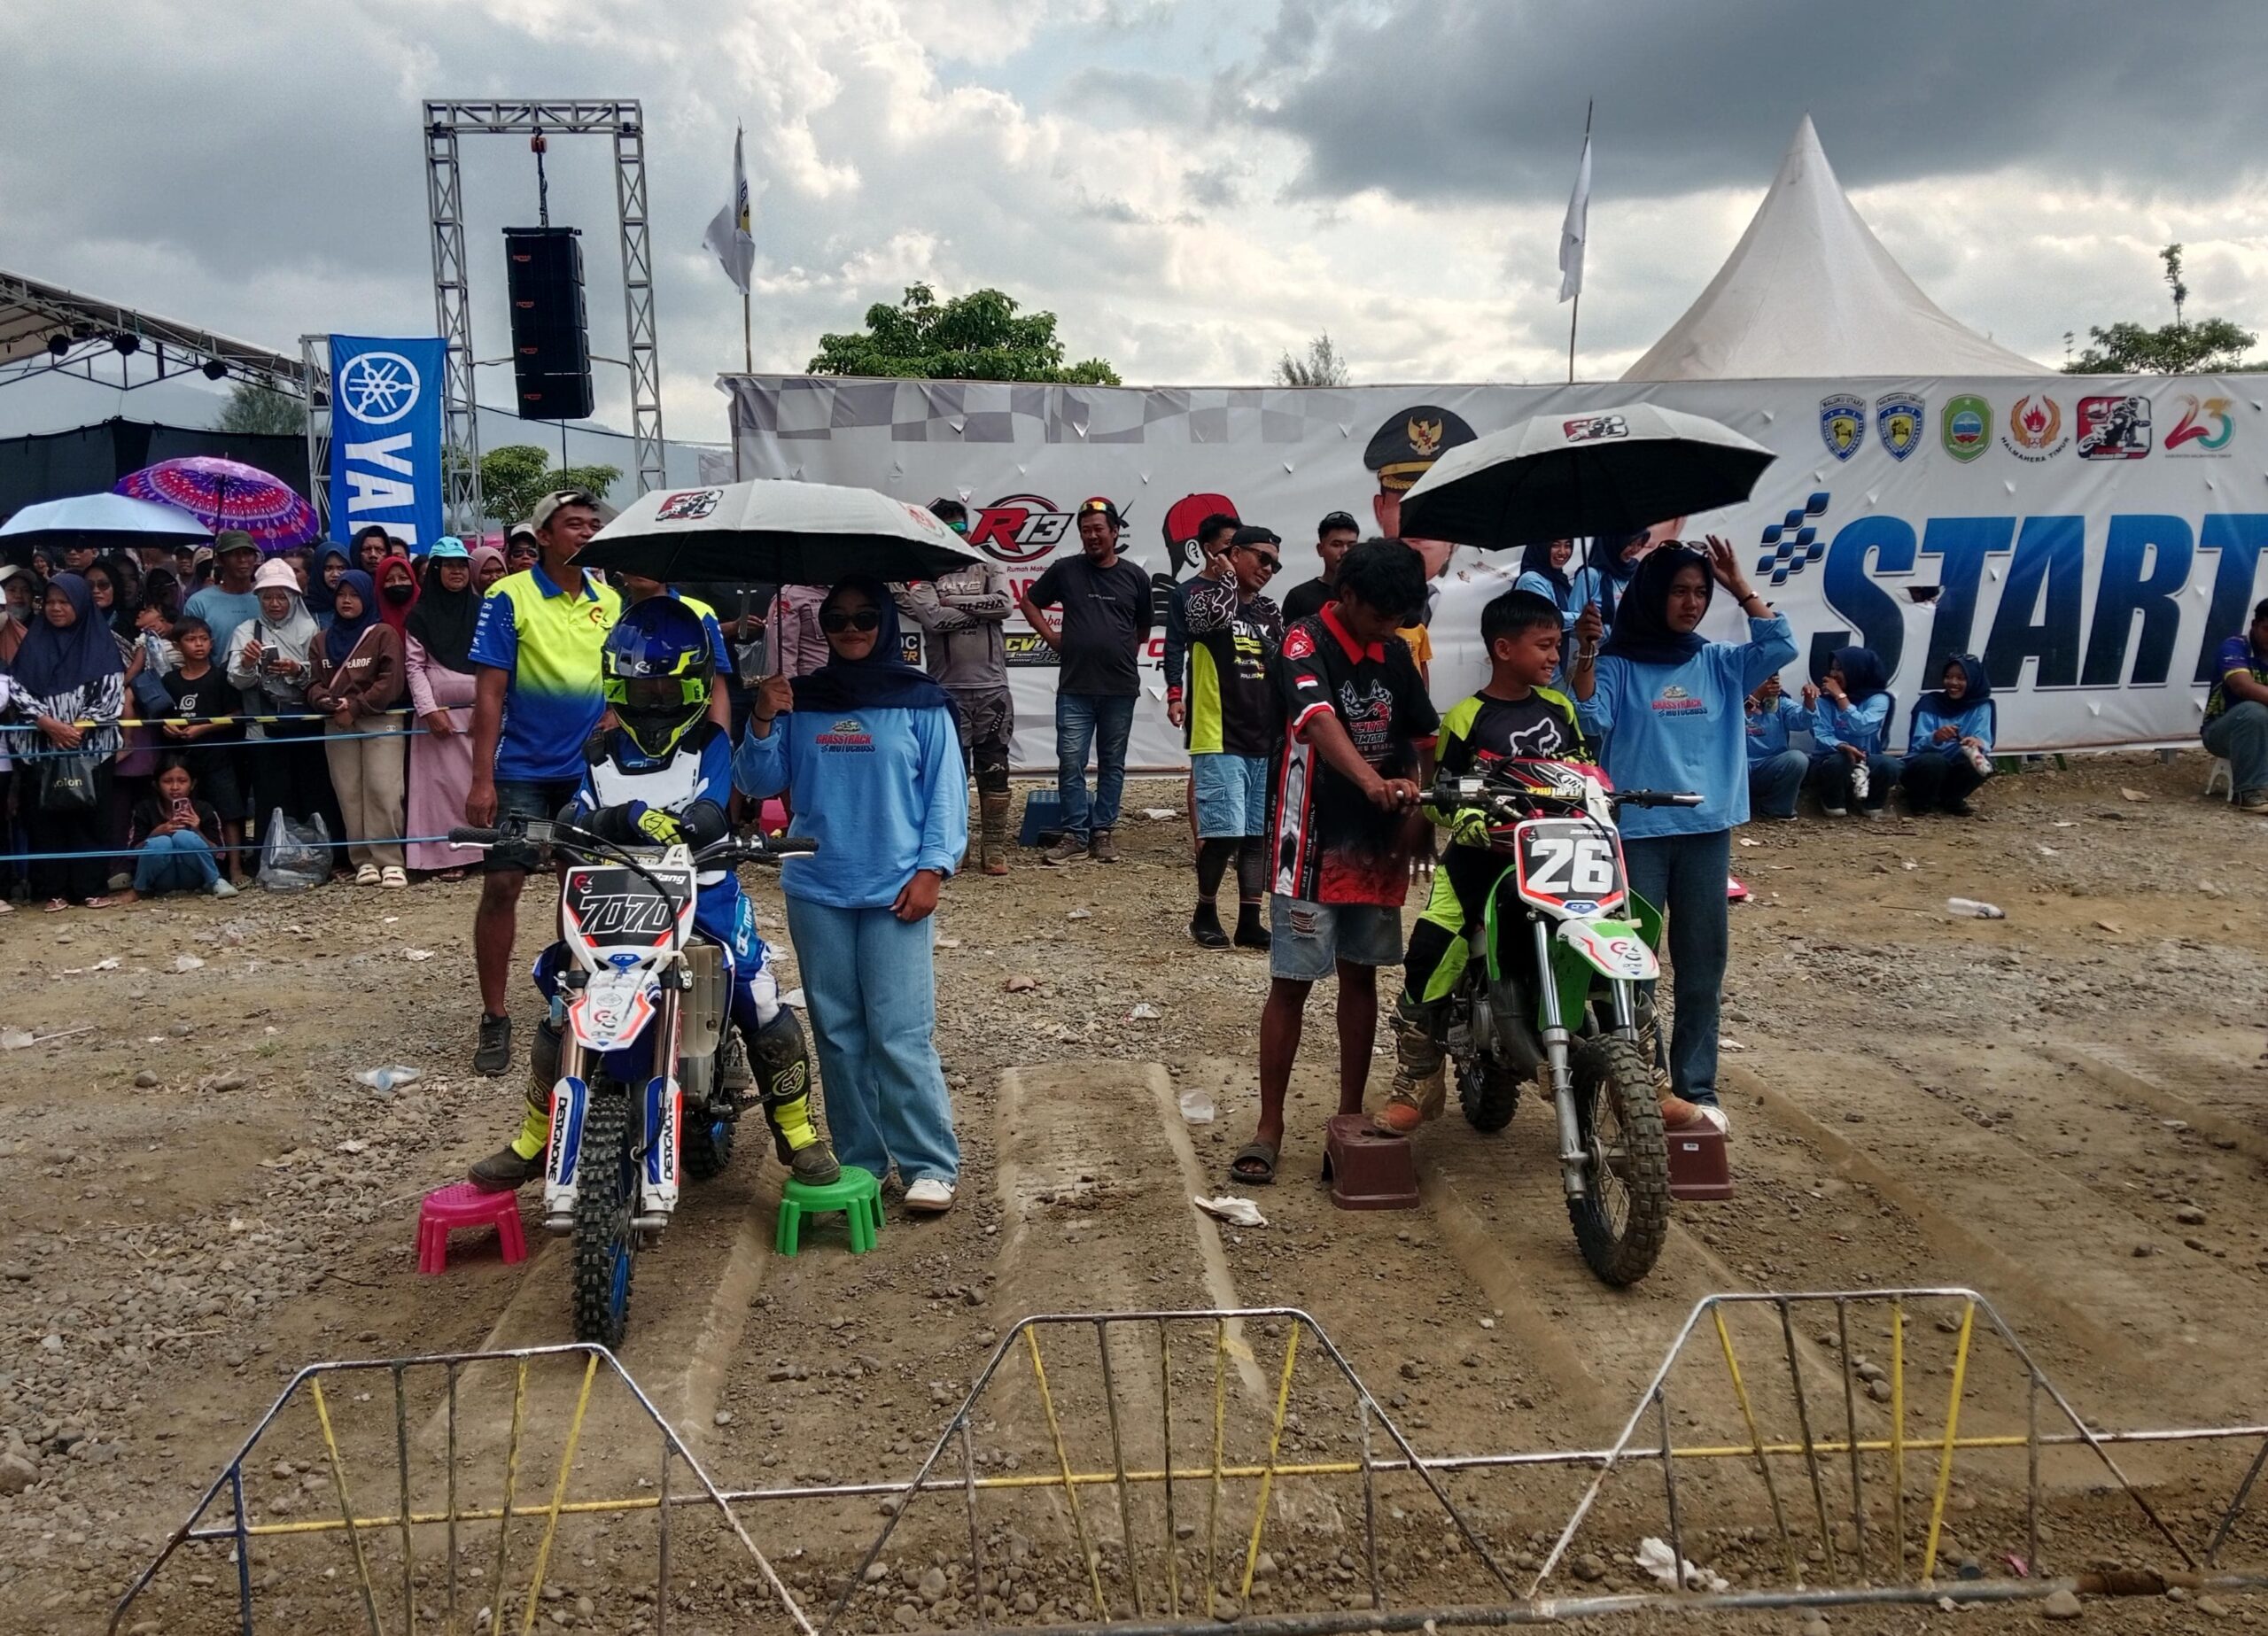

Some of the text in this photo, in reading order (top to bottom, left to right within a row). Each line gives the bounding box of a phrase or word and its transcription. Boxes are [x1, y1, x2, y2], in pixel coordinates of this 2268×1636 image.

[2000, 436, 2047, 462] HALMAHERA
[2047, 436, 2070, 459] TIMUR
[344, 431, 418, 560] YA
[967, 507, 1076, 555] R13
[1807, 514, 2268, 693] START
[900, 635, 918, 650] C
[816, 734, 872, 745] GRASSTRACK
[828, 744, 876, 753] MOTOCROSS
[1526, 838, 1614, 894] 26
[579, 894, 684, 936] 7070
[548, 1097, 568, 1182] DESIGNONE
